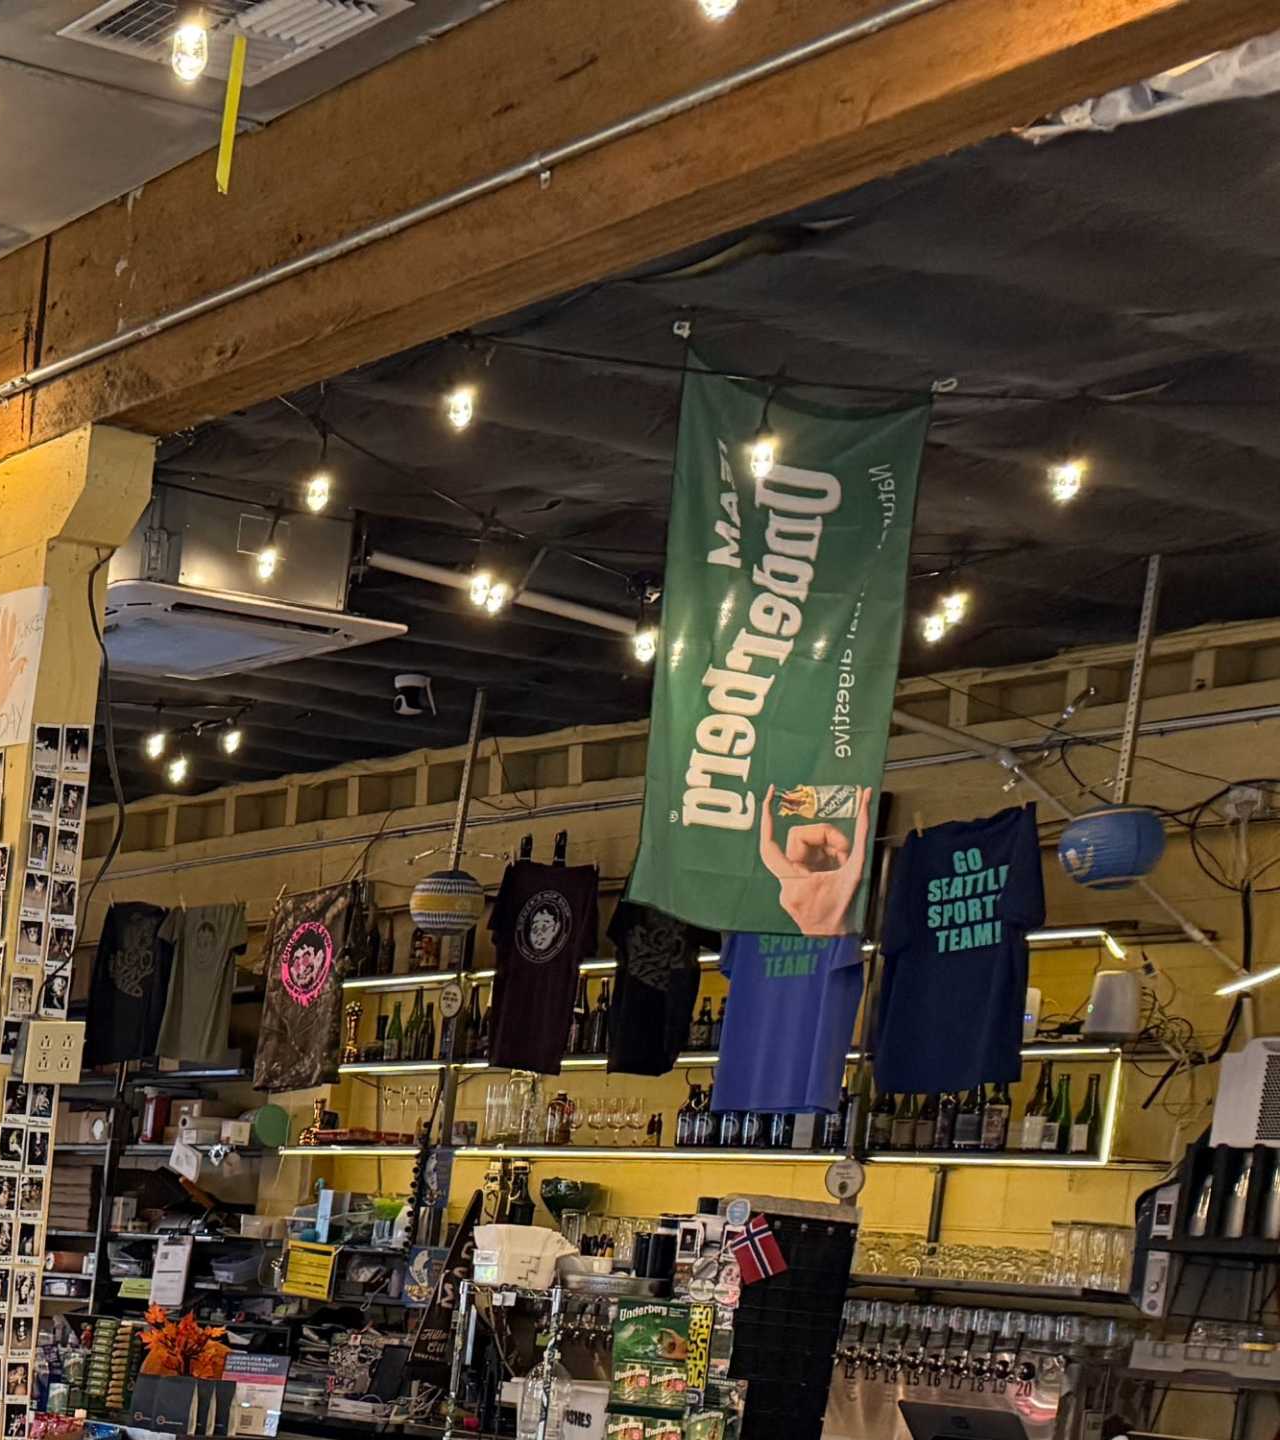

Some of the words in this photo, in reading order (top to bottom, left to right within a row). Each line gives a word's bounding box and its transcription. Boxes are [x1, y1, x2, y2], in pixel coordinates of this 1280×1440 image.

[953, 847, 983, 874] GO
[927, 894, 1002, 928] SPORT
[936, 920, 1002, 953] TEAM!
[764, 953, 820, 978] TEAM!
[619, 1304, 668, 1321] Underberg
[843, 1365, 856, 1379] 12
[884, 1369, 898, 1384] 14
[906, 1372, 920, 1386] 15
[926, 1373, 941, 1387] 16
[948, 1375, 963, 1390] 17
[970, 1378, 985, 1392] 18
[992, 1379, 1007, 1394] 19
[1015, 1382, 1032, 1397] 20
